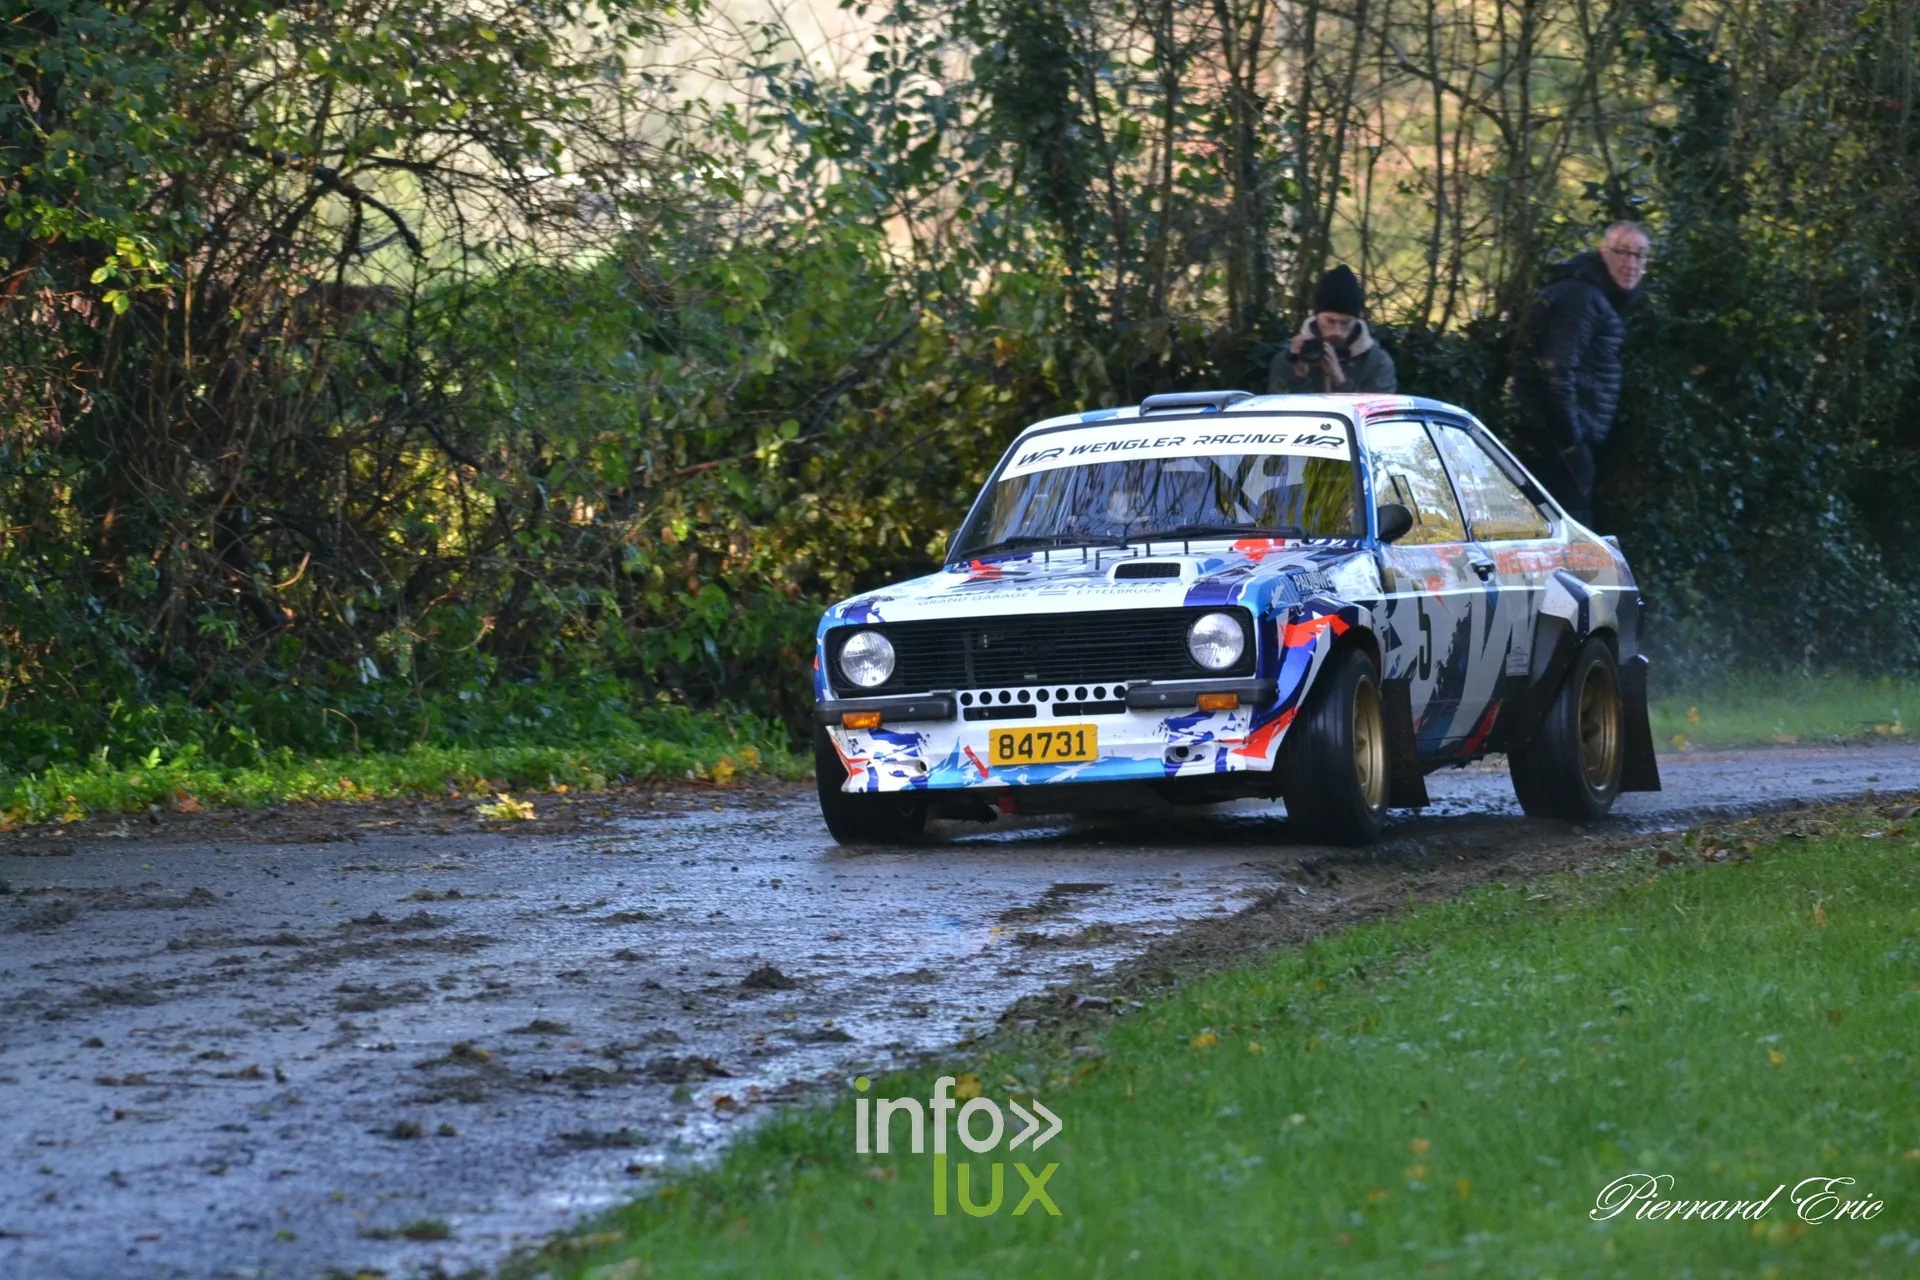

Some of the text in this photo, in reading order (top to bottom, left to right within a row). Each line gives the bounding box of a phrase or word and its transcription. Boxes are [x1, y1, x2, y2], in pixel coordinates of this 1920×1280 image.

[1069, 436, 1186, 456] WENGLER
[1193, 433, 1288, 445] RACING
[918, 596, 967, 606] GRAND
[972, 592, 1029, 602] GARAGE
[999, 730, 1086, 760] 84731
